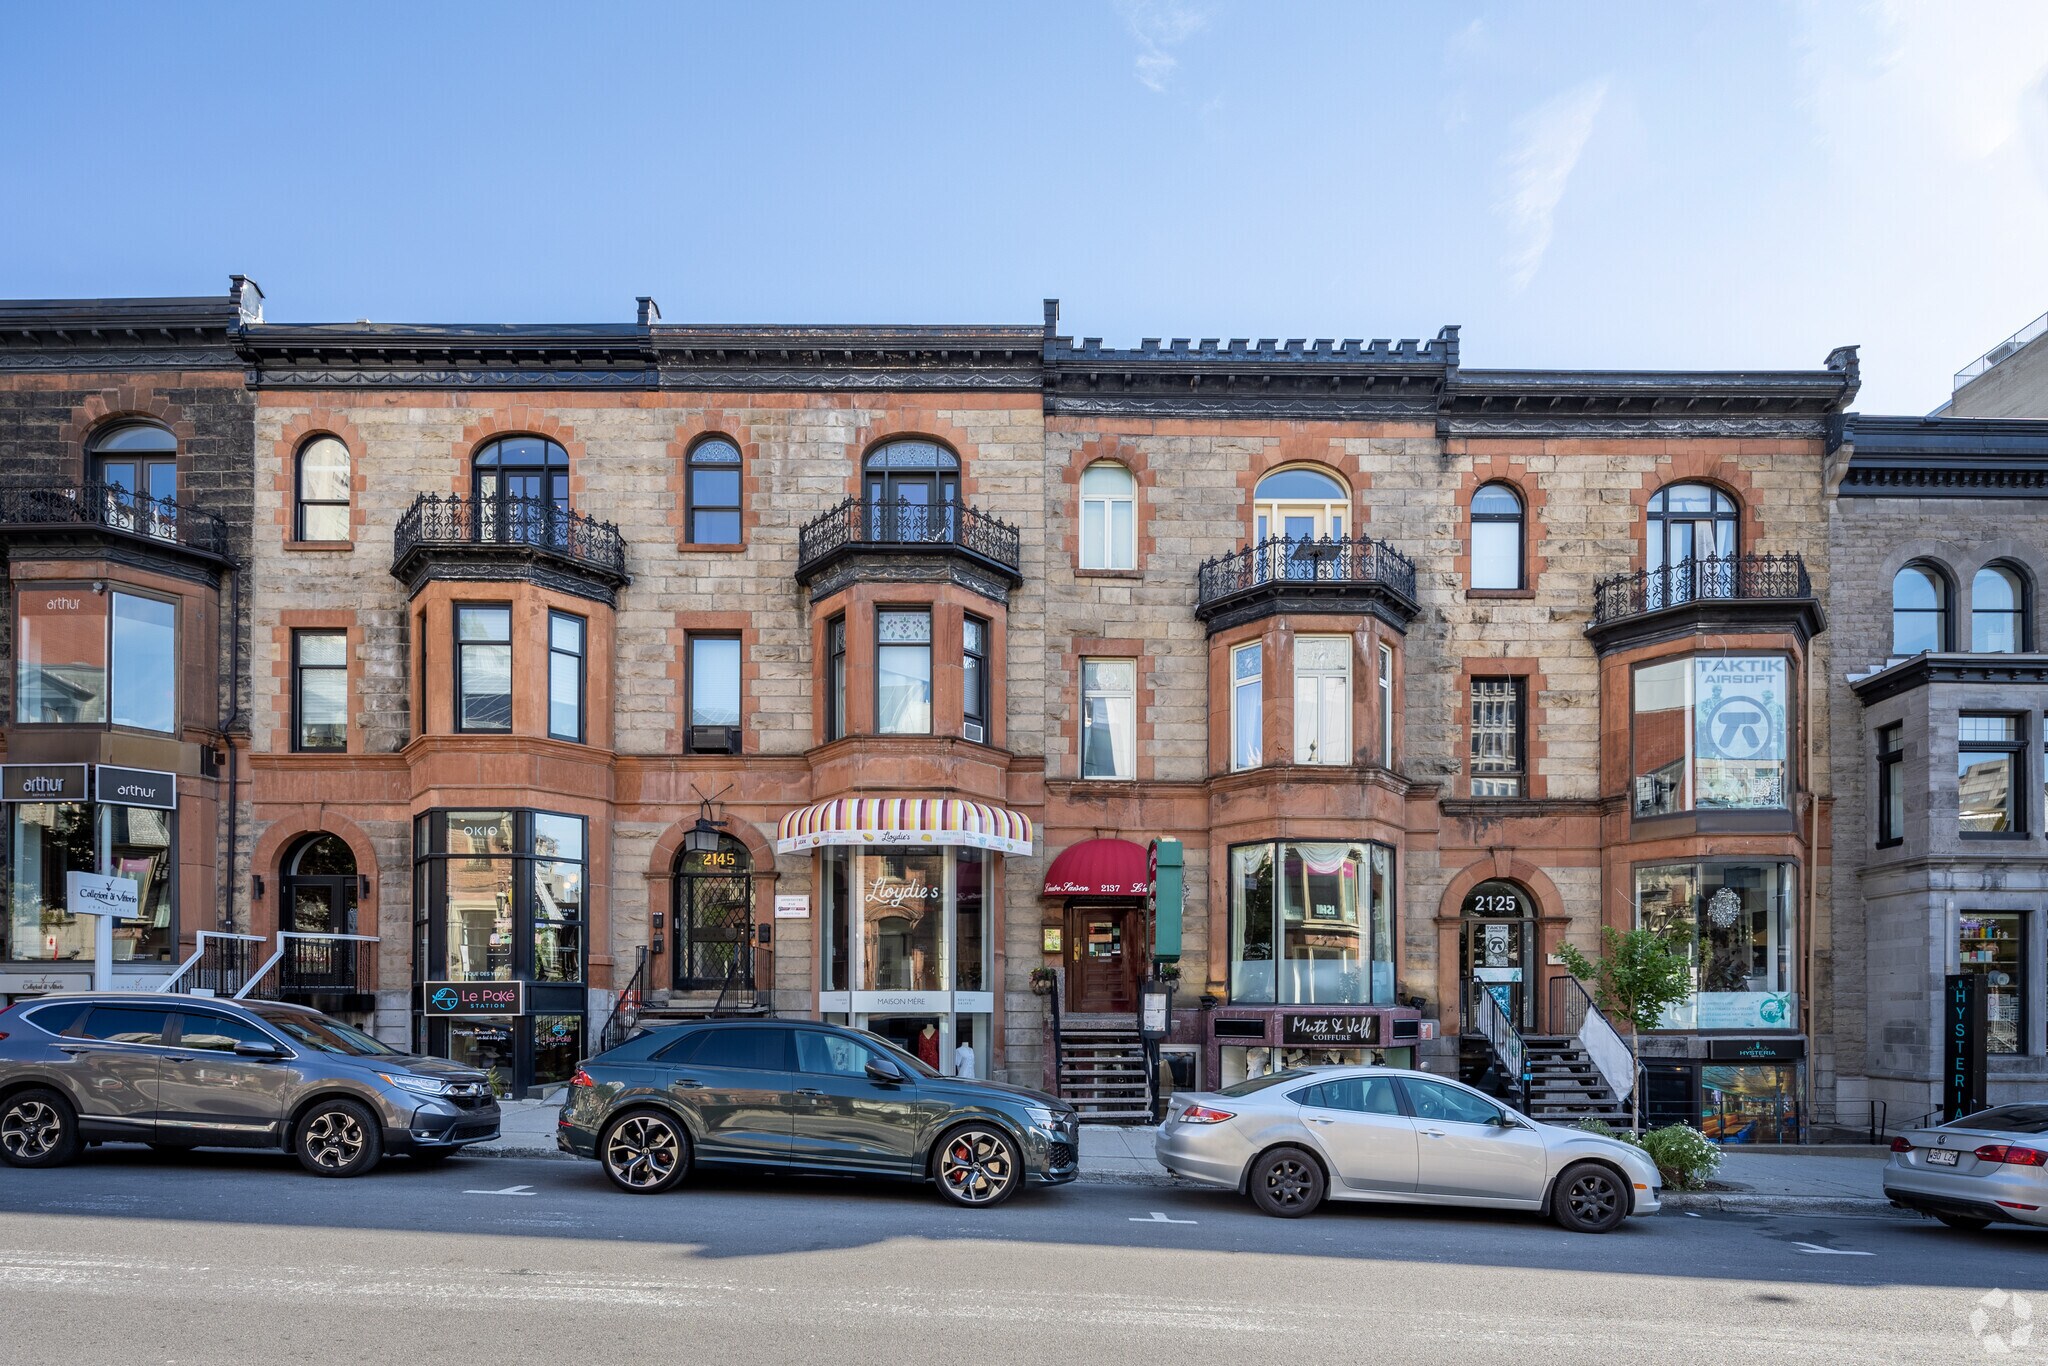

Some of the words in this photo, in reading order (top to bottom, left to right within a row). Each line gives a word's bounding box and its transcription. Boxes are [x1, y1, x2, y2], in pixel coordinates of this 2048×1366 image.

[47, 597, 80, 610] arthur
[1697, 660, 1783, 672] TAKTIK
[1705, 675, 1775, 684] AIRSOFT
[23, 776, 64, 792] arthur
[117, 785, 156, 798] arthur
[464, 826, 498, 836] OKIO
[881, 831, 910, 843] Lloydie's
[703, 853, 735, 865] 2145
[1101, 884, 1120, 892] 2137
[1475, 895, 1516, 911] 2125
[462, 990, 478, 1002] Le
[483, 989, 515, 1002] Poké
[907, 997, 926, 1005] MÈRE
[1293, 1017, 1328, 1032] Mutt
[1331, 1018, 1343, 1032] &
[1347, 1017, 1371, 1039] Jeff
[1955, 990, 1966, 1120] HYSTERIA
